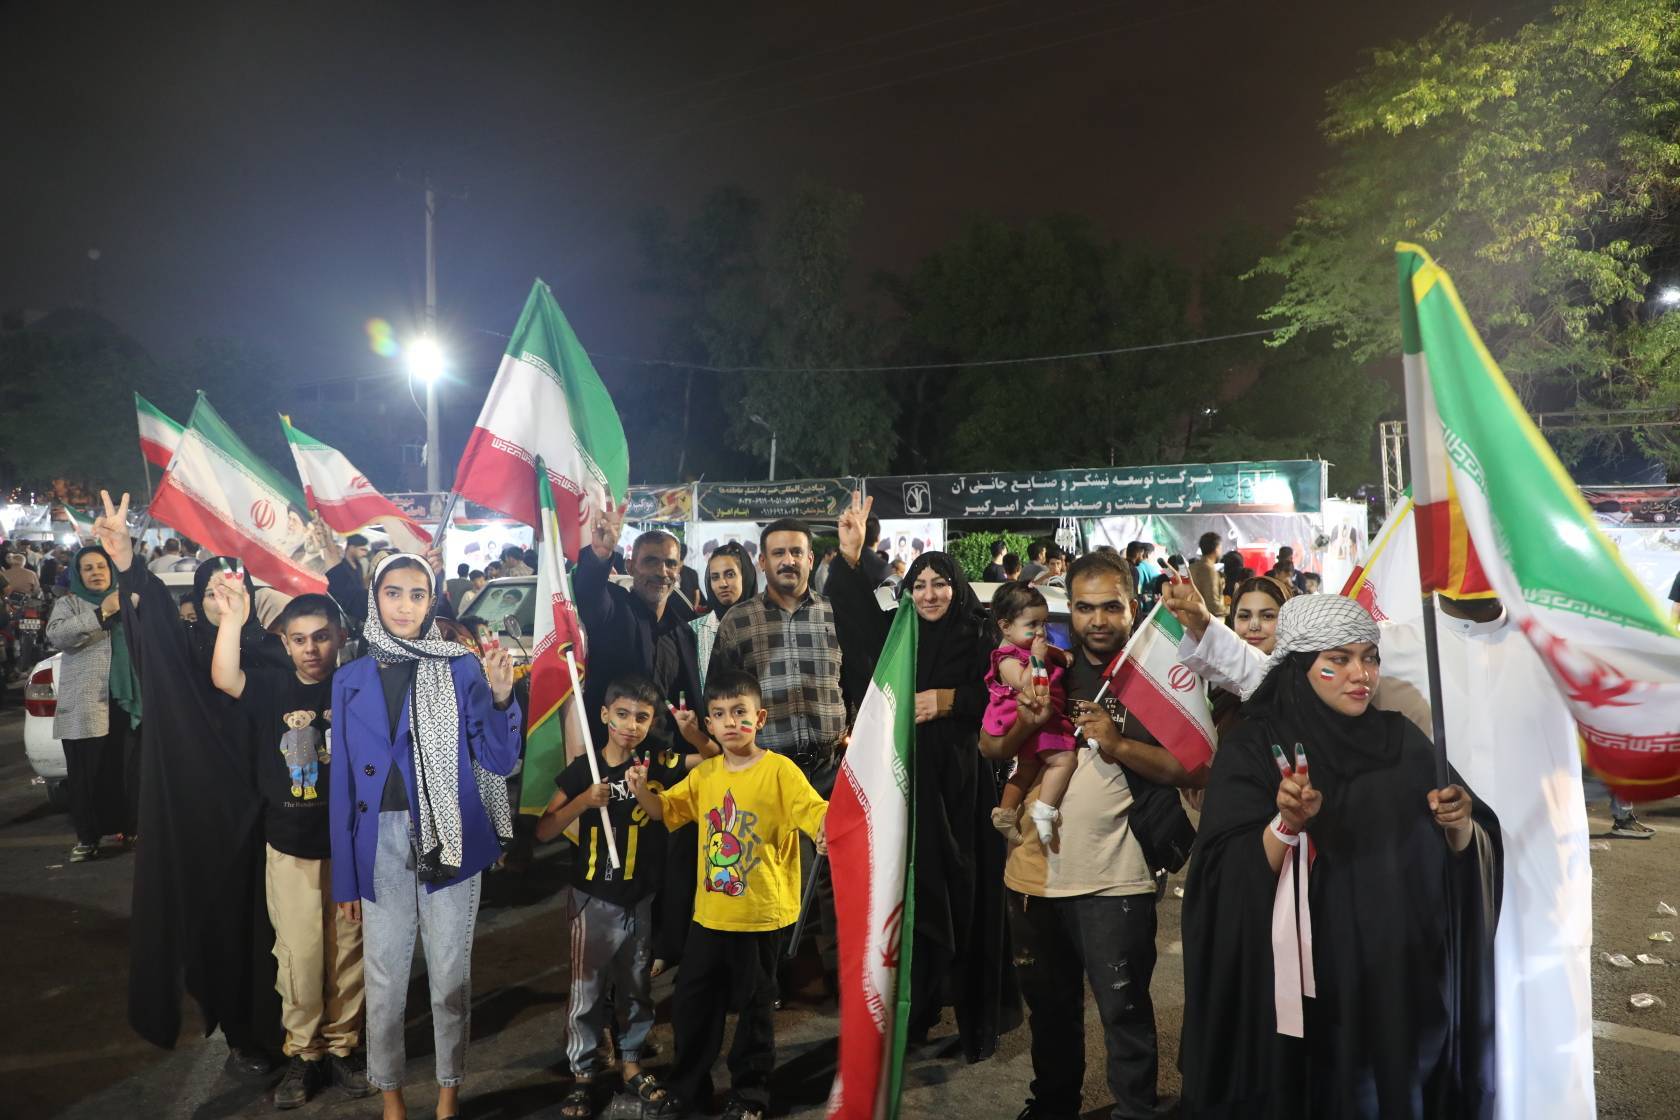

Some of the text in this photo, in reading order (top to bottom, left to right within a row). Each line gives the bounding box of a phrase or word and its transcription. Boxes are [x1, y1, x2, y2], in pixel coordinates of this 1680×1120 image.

[951, 477, 966, 494] آن
[969, 477, 1007, 495] جانبی
[1010, 475, 1058, 493] صنایع
[1060, 478, 1067, 491] و
[1069, 472, 1110, 492] نیشکر
[1112, 471, 1154, 489] توسعه
[1157, 469, 1214, 488] شرکت
[1021, 498, 1059, 515] نیشکر
[1061, 499, 1102, 512] صنعت
[1105, 501, 1112, 514] و
[1114, 495, 1152, 510] کشت
[1155, 494, 1203, 512] شرکت
